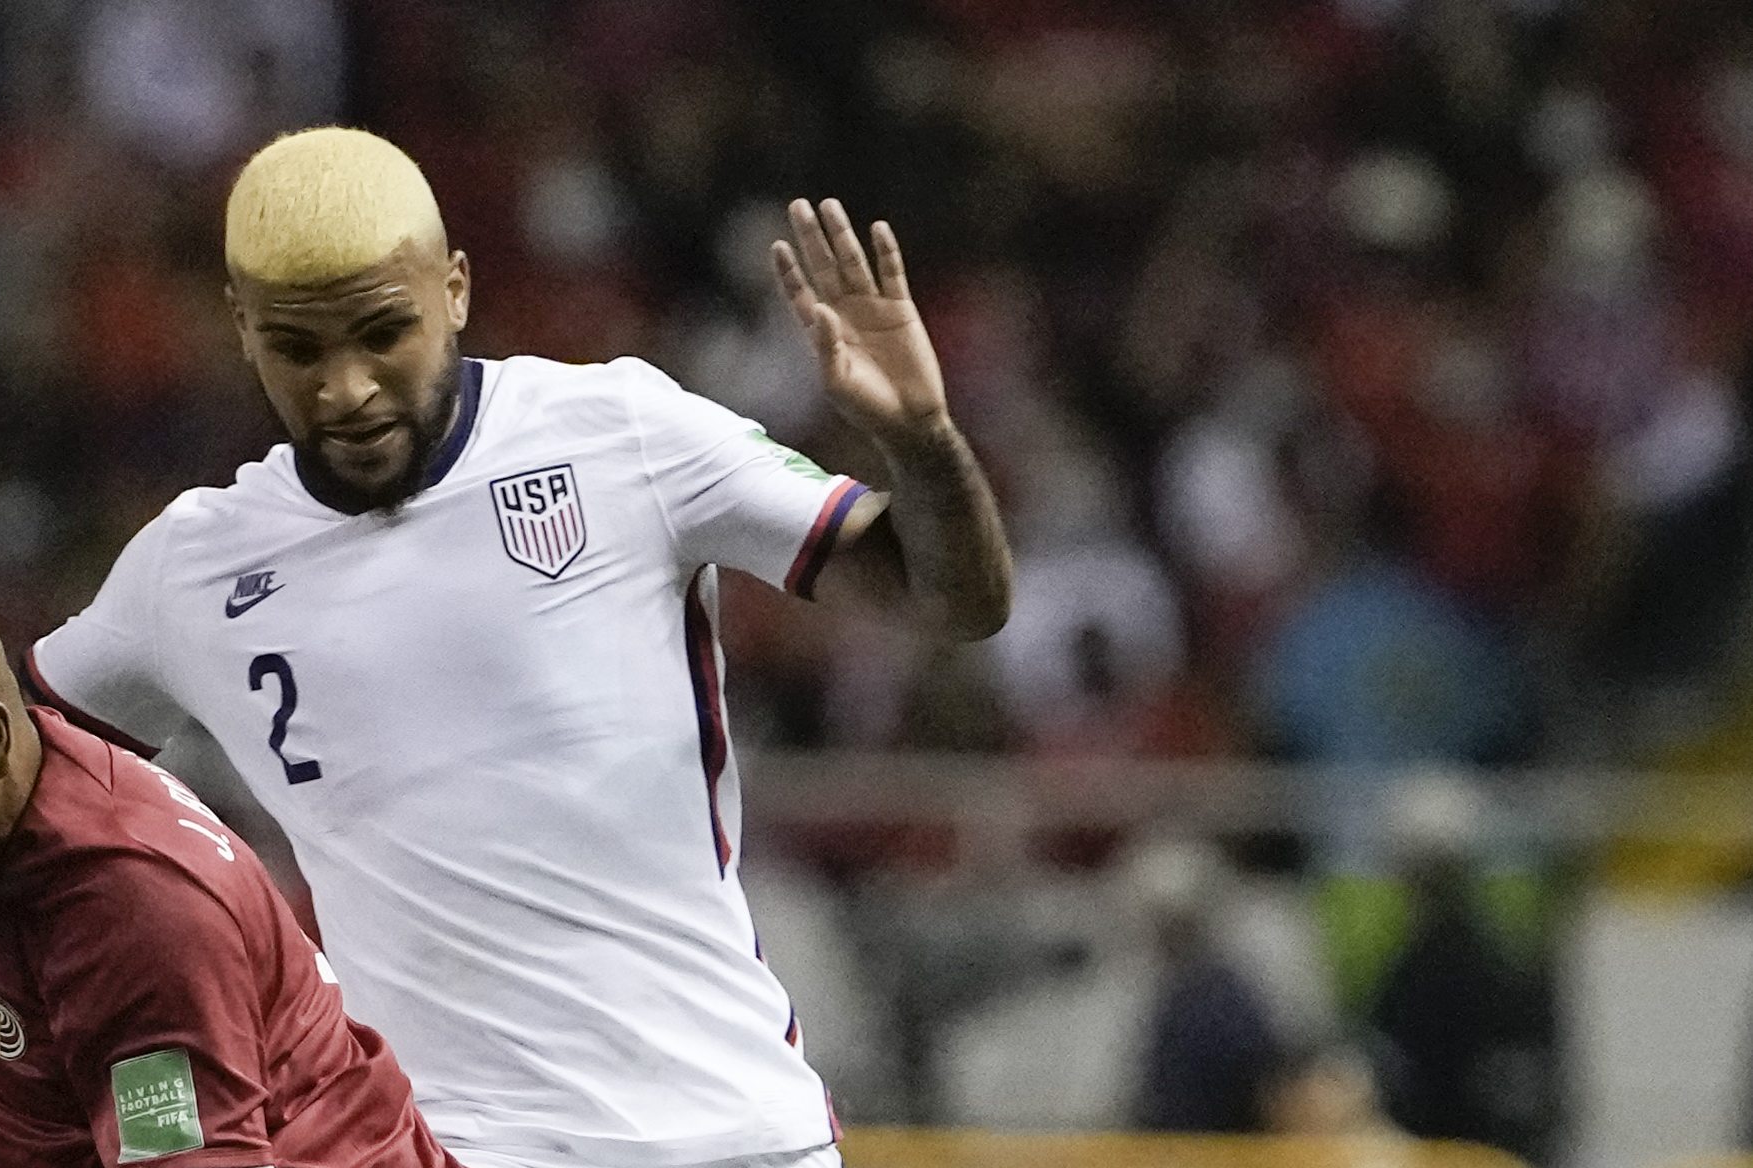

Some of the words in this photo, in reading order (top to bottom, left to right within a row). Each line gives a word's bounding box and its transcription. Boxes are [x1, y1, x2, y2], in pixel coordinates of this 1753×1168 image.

[500, 473, 568, 515] USA
[249, 653, 323, 785] 2
[119, 1078, 185, 1103] LIVING
[121, 1089, 186, 1114] FOOTBALL
[157, 1110, 188, 1127] FIFA
